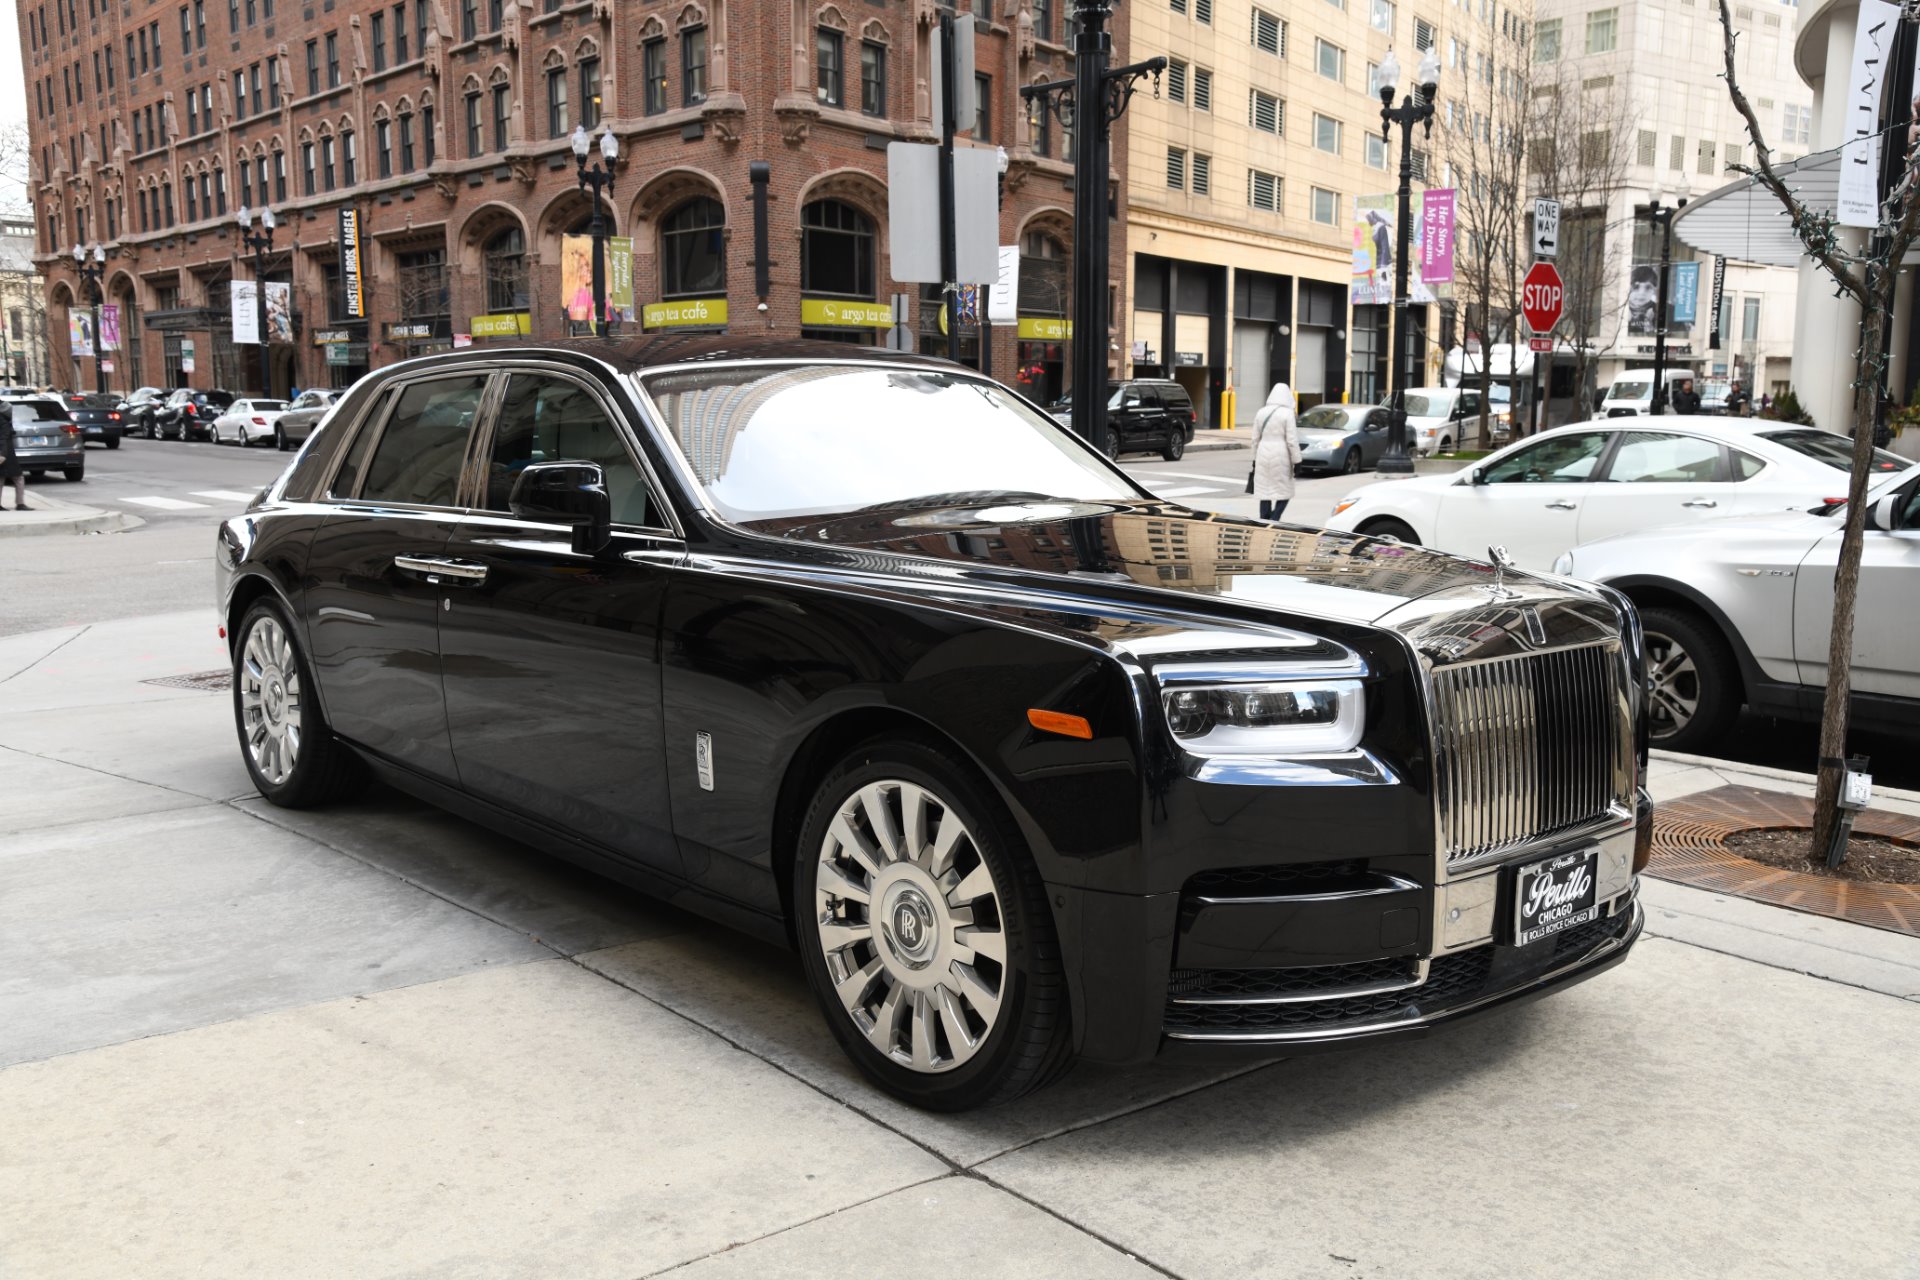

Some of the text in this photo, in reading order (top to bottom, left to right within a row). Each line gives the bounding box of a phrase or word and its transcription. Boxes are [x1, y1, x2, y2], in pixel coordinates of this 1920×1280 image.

[1538, 203, 1557, 218] ONE
[343, 210, 356, 246] BAGELS
[1424, 206, 1436, 265] My Dreams
[1437, 206, 1449, 257] Her Story,
[1537, 219, 1556, 234] WAY
[346, 274, 359, 315] EINSTEIN
[1524, 283, 1561, 312] STOP
[496, 315, 516, 331] café
[666, 308, 679, 320] tea
[682, 301, 708, 319] café
[842, 308, 865, 324] argo
[866, 308, 878, 322] tea
[1531, 340, 1551, 350] ALL WAY
[1523, 864, 1591, 918] Perillo
[1529, 912, 1588, 940] ROLLS ROYCE CHICAGO
[1538, 903, 1573, 925] CHICAGO
